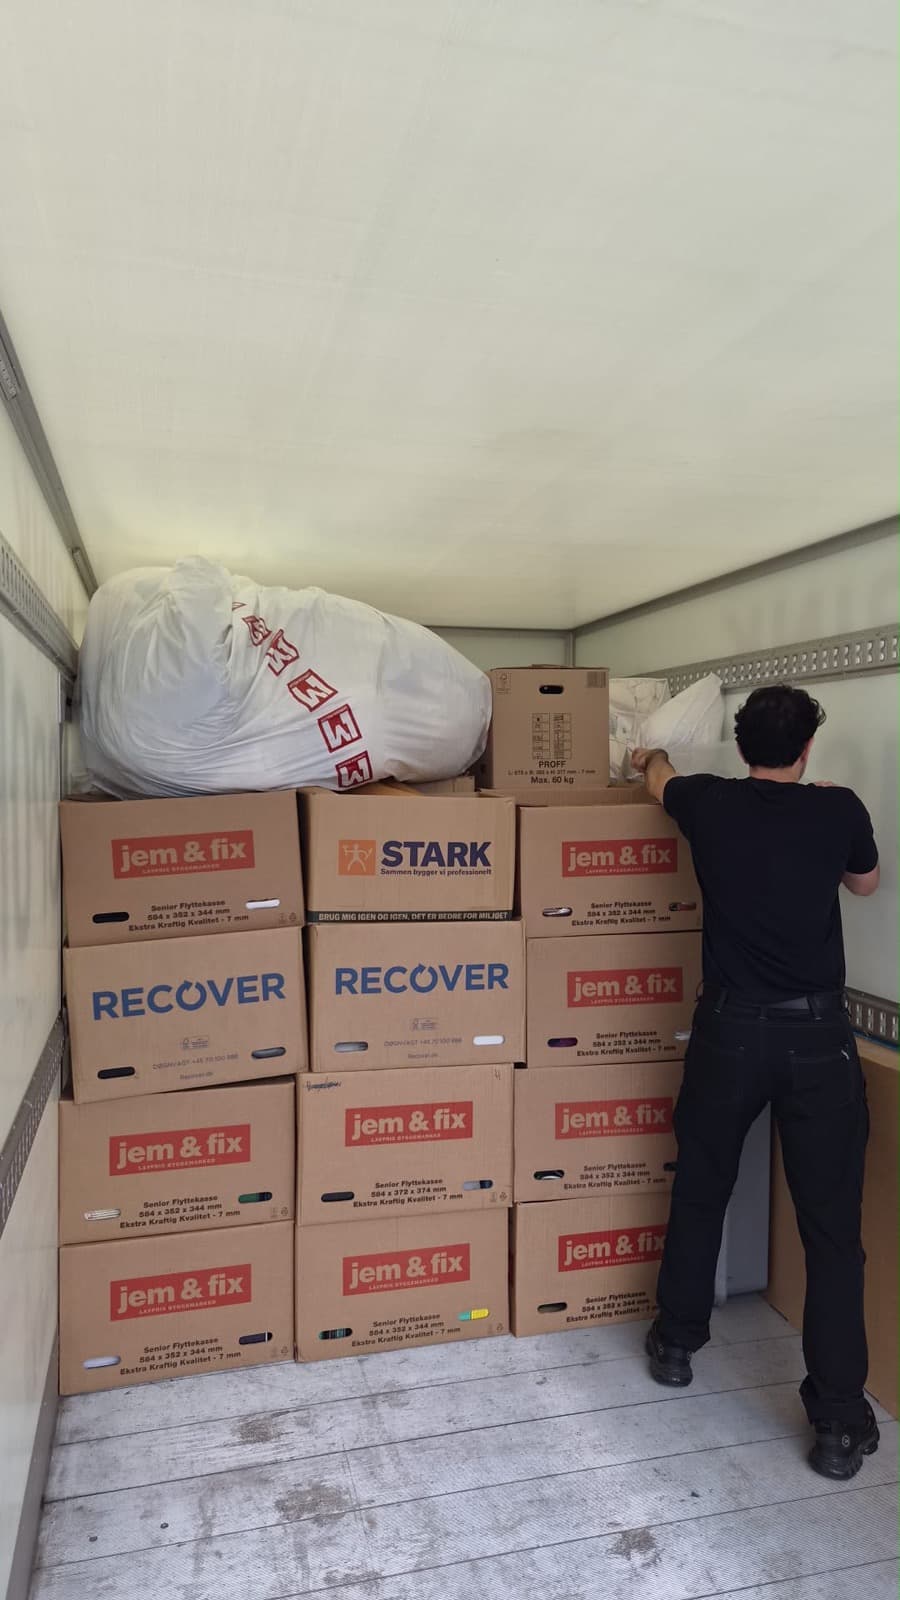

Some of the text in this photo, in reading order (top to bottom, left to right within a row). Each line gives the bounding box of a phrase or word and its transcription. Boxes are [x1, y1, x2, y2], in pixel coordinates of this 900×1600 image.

[564, 776, 574, 784] kg
[120, 845, 177, 872] jem
[184, 841, 206, 863] &
[210, 838, 246, 860] fix
[381, 841, 491, 867] STARK
[568, 845, 671, 871] jem & fix
[447, 868, 491, 876] professionelt
[158, 920, 185, 928] Kraftig
[336, 963, 509, 995] RECOVER
[574, 974, 676, 1001] jem & fix
[92, 972, 285, 1021] RECOVER
[352, 1108, 466, 1140] jem & fix
[561, 1109, 608, 1133] jem
[614, 1106, 632, 1125] &
[636, 1105, 666, 1124] fix
[117, 1133, 242, 1169] jem & fix
[402, 1179, 442, 1187] Flyttekasse
[172, 1196, 218, 1205] Flyttekasse
[180, 1214, 210, 1222] Kvalitet
[564, 1241, 610, 1266] jem
[615, 1235, 633, 1255] &
[637, 1232, 665, 1252] fix
[350, 1252, 463, 1289] jem & fix
[118, 1274, 244, 1314] jem & fix
[399, 1314, 440, 1323] Flyttekasse
[144, 1338, 218, 1353] Senior Flyttekasse
[378, 1335, 402, 1343] Kraftig
[405, 1331, 433, 1339] Kvalitet
[150, 1362, 177, 1370] Kraftig
[180, 1356, 210, 1366] Kvalitet
